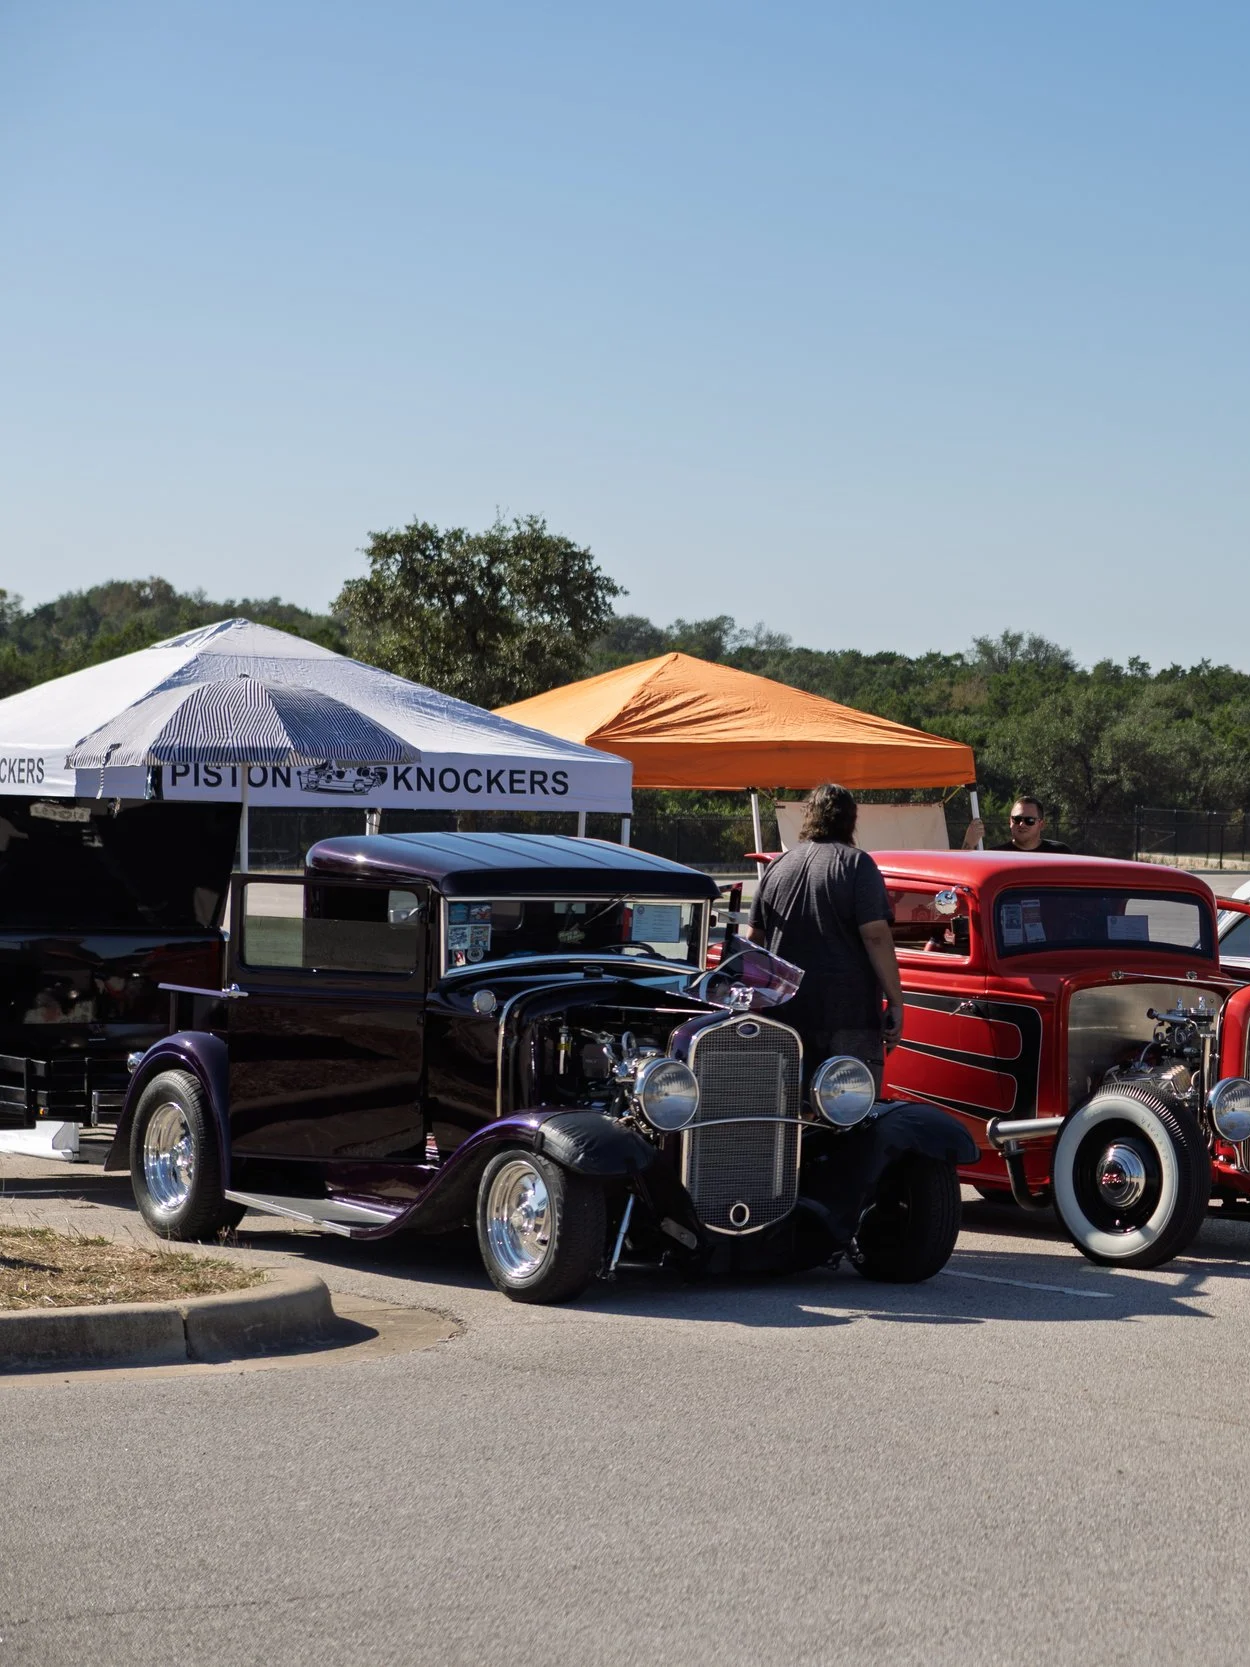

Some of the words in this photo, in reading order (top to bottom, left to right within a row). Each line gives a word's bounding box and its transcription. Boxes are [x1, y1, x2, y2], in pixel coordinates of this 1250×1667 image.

[0, 758, 45, 784] CKERS
[171, 763, 291, 788] PISTON
[393, 766, 569, 796] KNOCKERS
